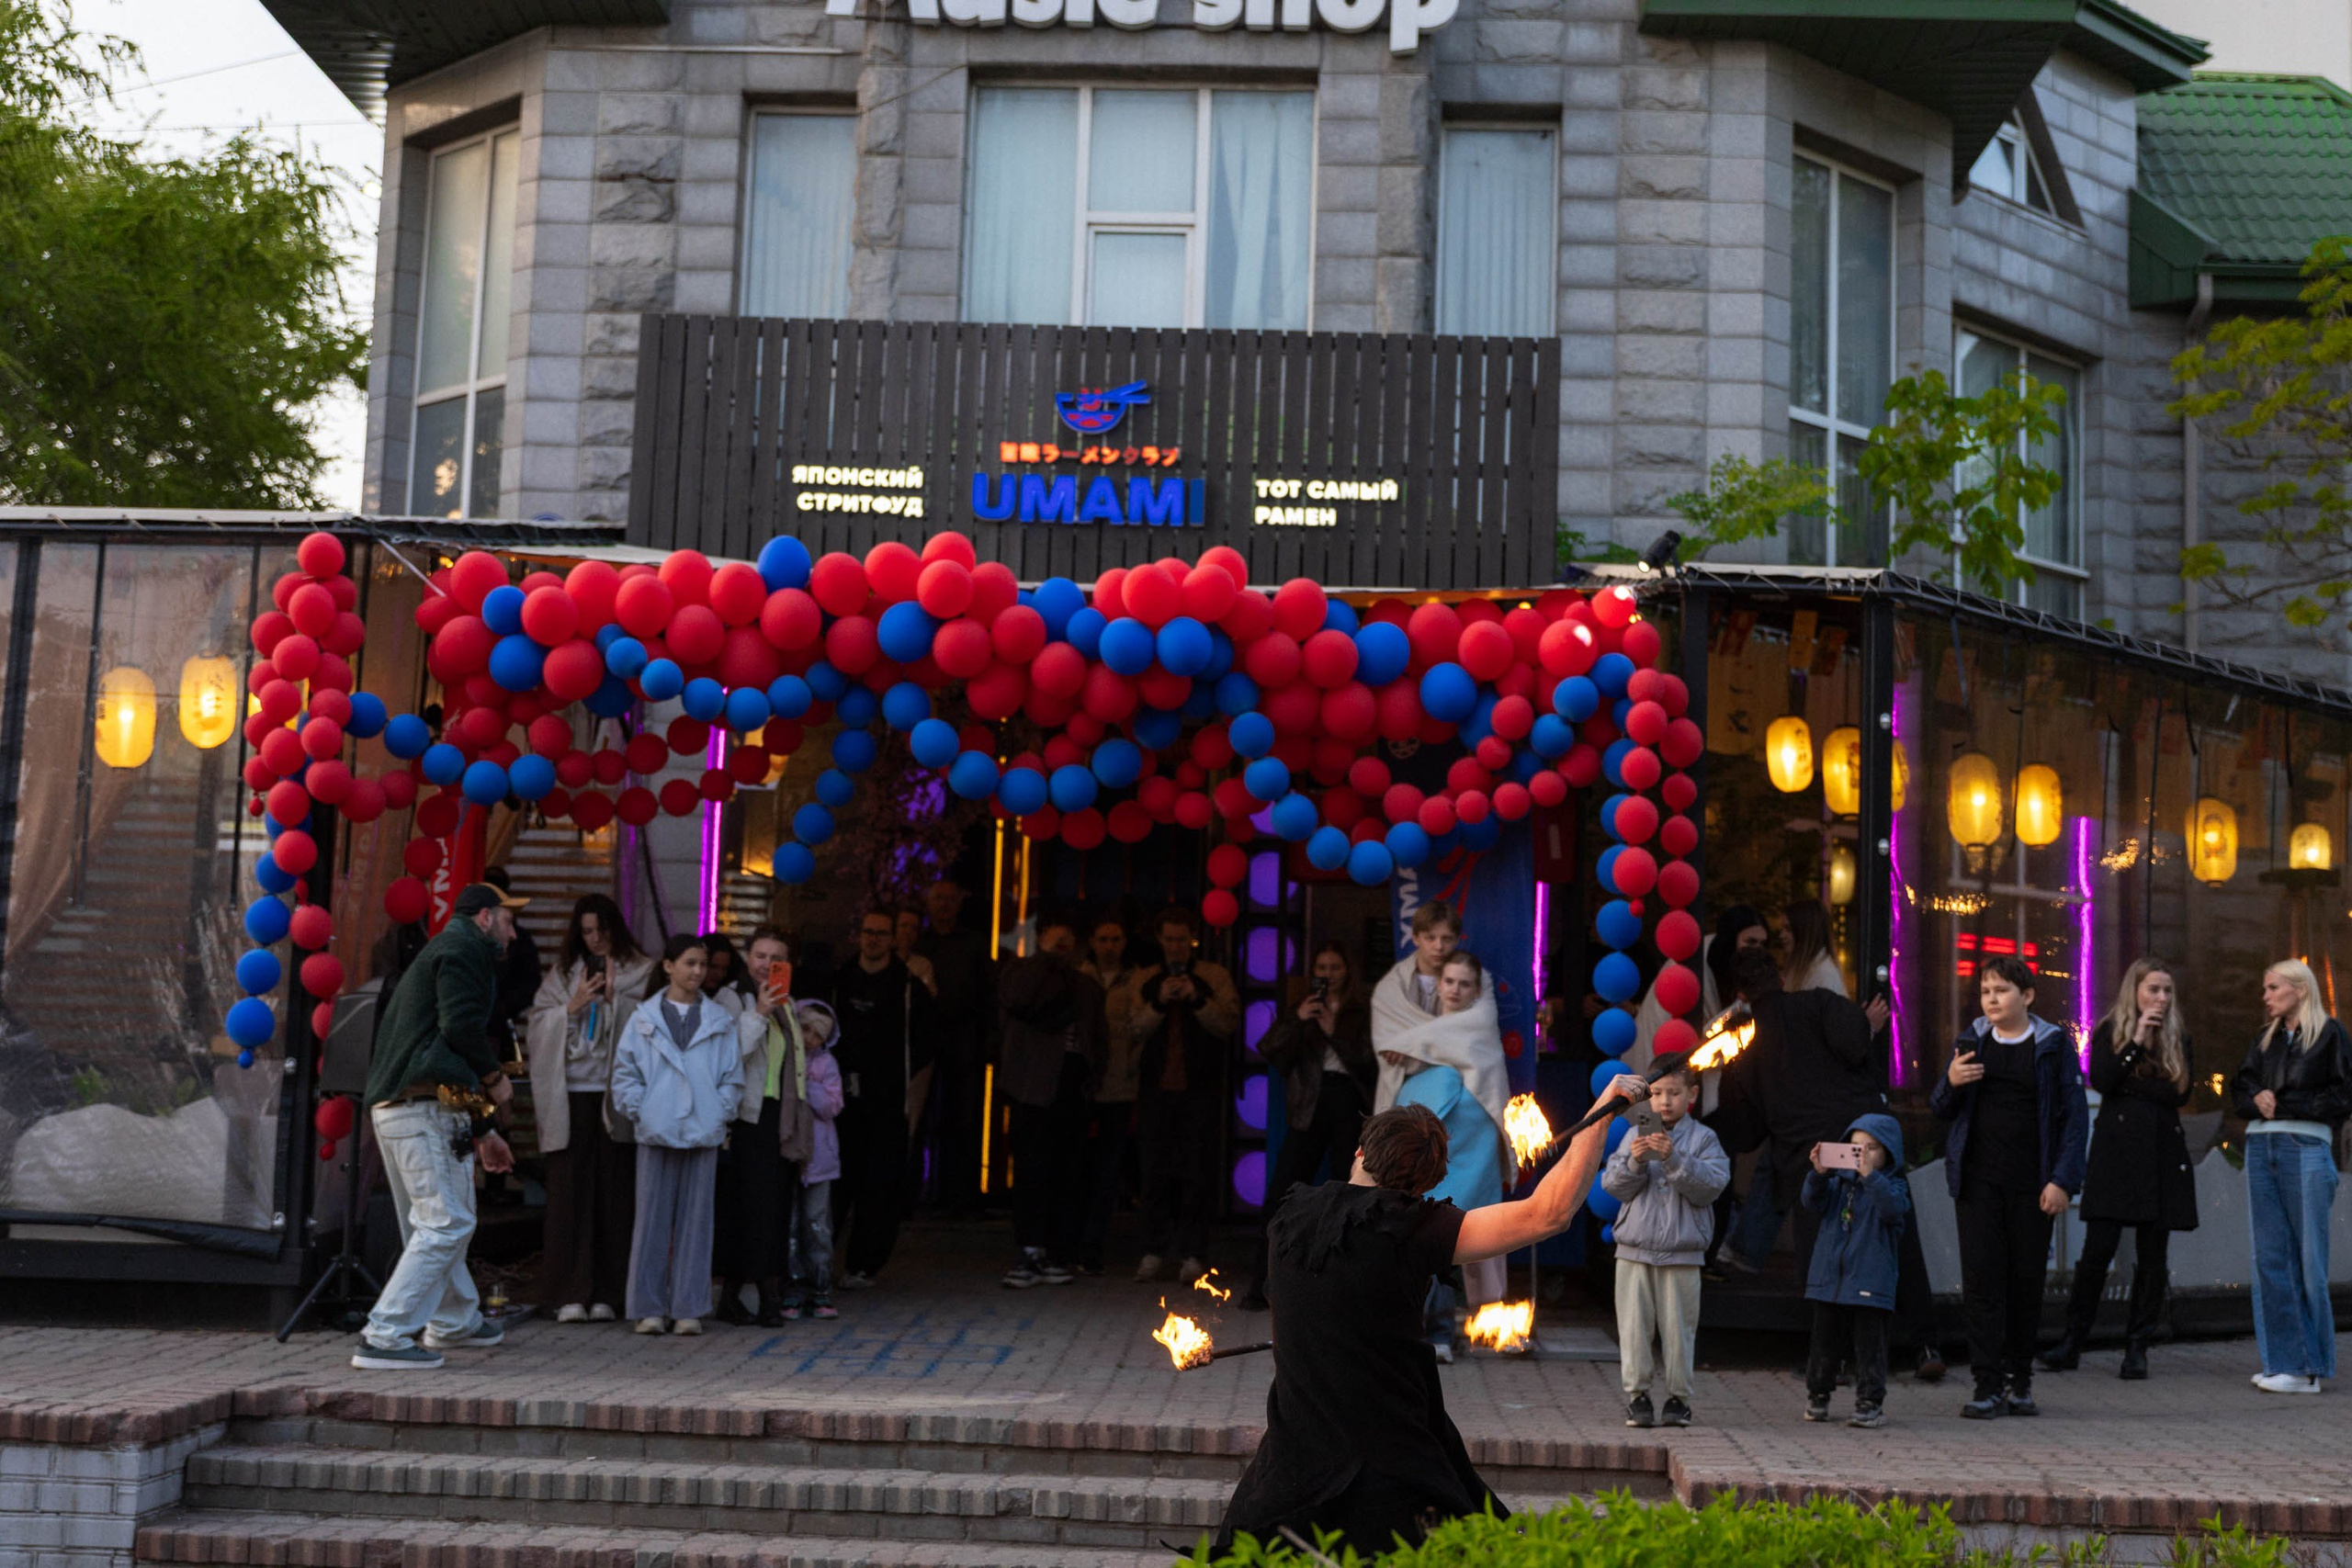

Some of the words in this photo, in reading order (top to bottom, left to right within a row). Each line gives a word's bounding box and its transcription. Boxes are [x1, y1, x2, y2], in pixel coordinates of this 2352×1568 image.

[792, 465, 924, 489] ЯПОНСКИЙ
[972, 472, 1204, 526] UMAMI
[1255, 479, 1303, 499] ТОТ
[1306, 479, 1399, 501] САМЫЙ
[797, 491, 924, 518] СТРИТФУД
[1254, 505, 1338, 526] РАМЕН
